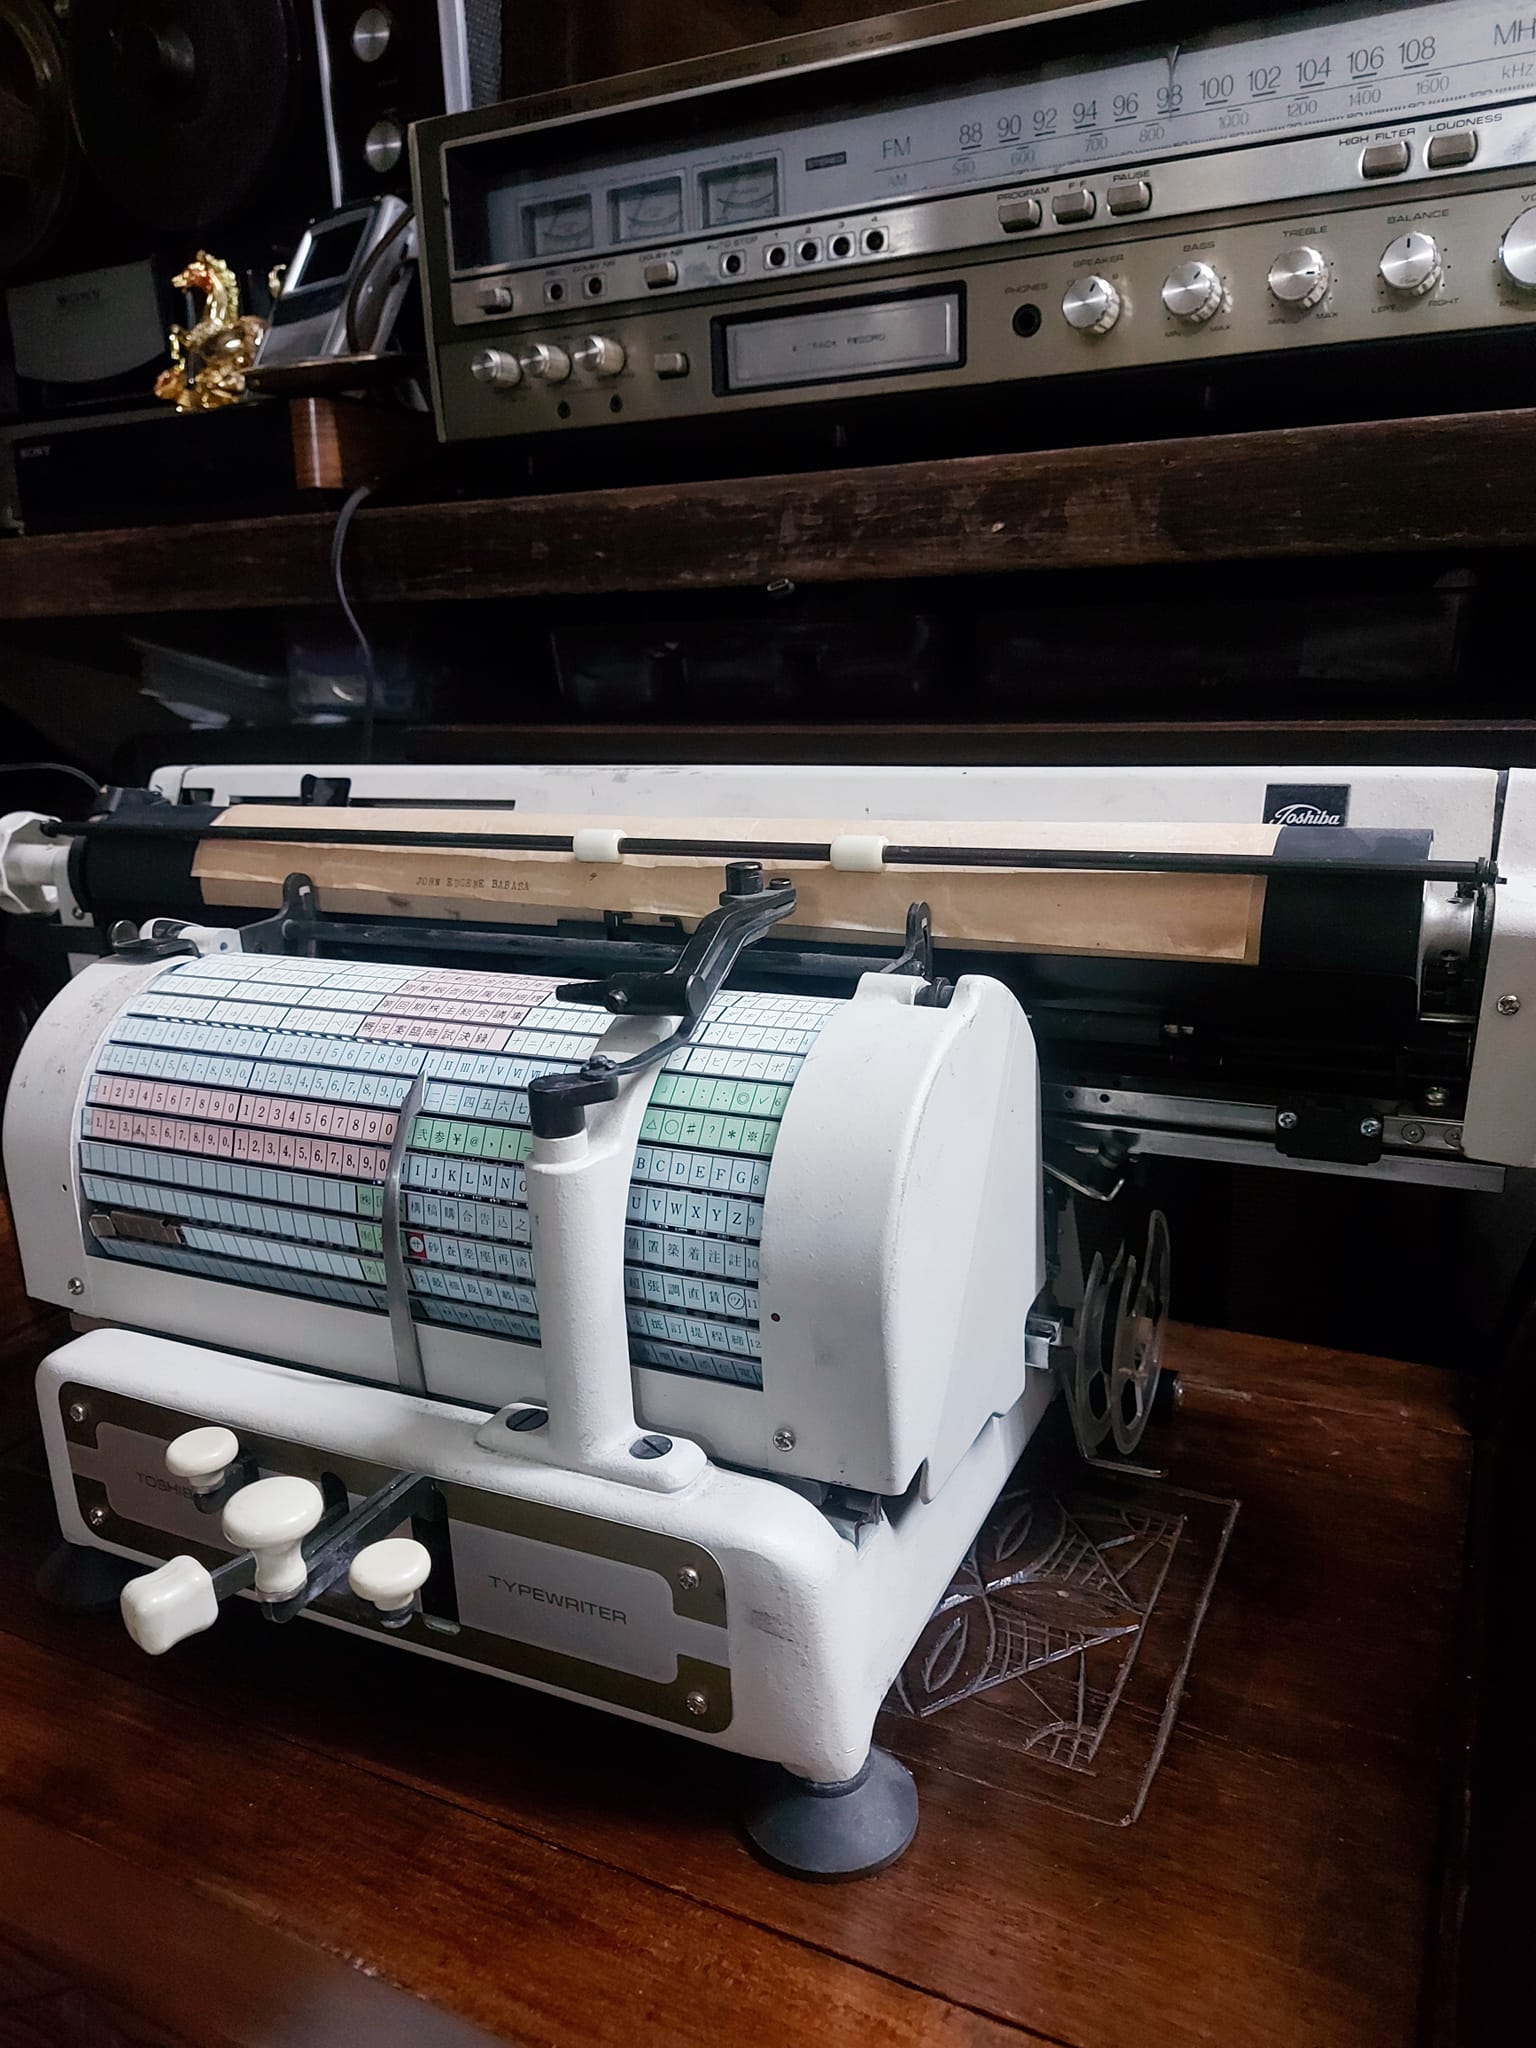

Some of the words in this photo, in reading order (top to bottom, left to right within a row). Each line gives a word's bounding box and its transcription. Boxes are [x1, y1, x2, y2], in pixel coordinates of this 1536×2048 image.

[882, 136, 911, 159] FM
[959, 122, 982, 145] 88
[997, 115, 1022, 138] 90
[1032, 108, 1058, 131] 92
[1072, 100, 1098, 124] 94
[1112, 92, 1138, 117] 96
[1200, 75, 1234, 98] 100
[1248, 66, 1282, 91] 102
[1296, 56, 1331, 82] 104
[1346, 46, 1385, 72] 106
[1399, 37, 1436, 63] 108
[1494, 18, 1536, 46] MH
[1084, 136, 1108, 152] 700
[1138, 126, 1165, 143] 800
[1218, 111, 1249, 128] 1000
[1287, 100, 1318, 117] 1200
[1349, 88, 1381, 107] 1400
[1416, 76, 1450, 95] 1600
[1502, 63, 1534, 80] kHz
[1429, 113, 1503, 133] LOUDNESS
[1338, 134, 1369, 147] HIGH
[1375, 128, 1416, 141] FILTER
[1113, 169, 1151, 183] PAUSE
[997, 186, 1050, 201] PROGRAM
[1387, 209, 1450, 224] BALANCE
[1283, 225, 1328, 238] TREBLE
[1270, 803, 1341, 826] Toshiba
[136, 1472, 193, 1499] TOSHIB
[489, 1575, 627, 1625] TYPEWRITER
